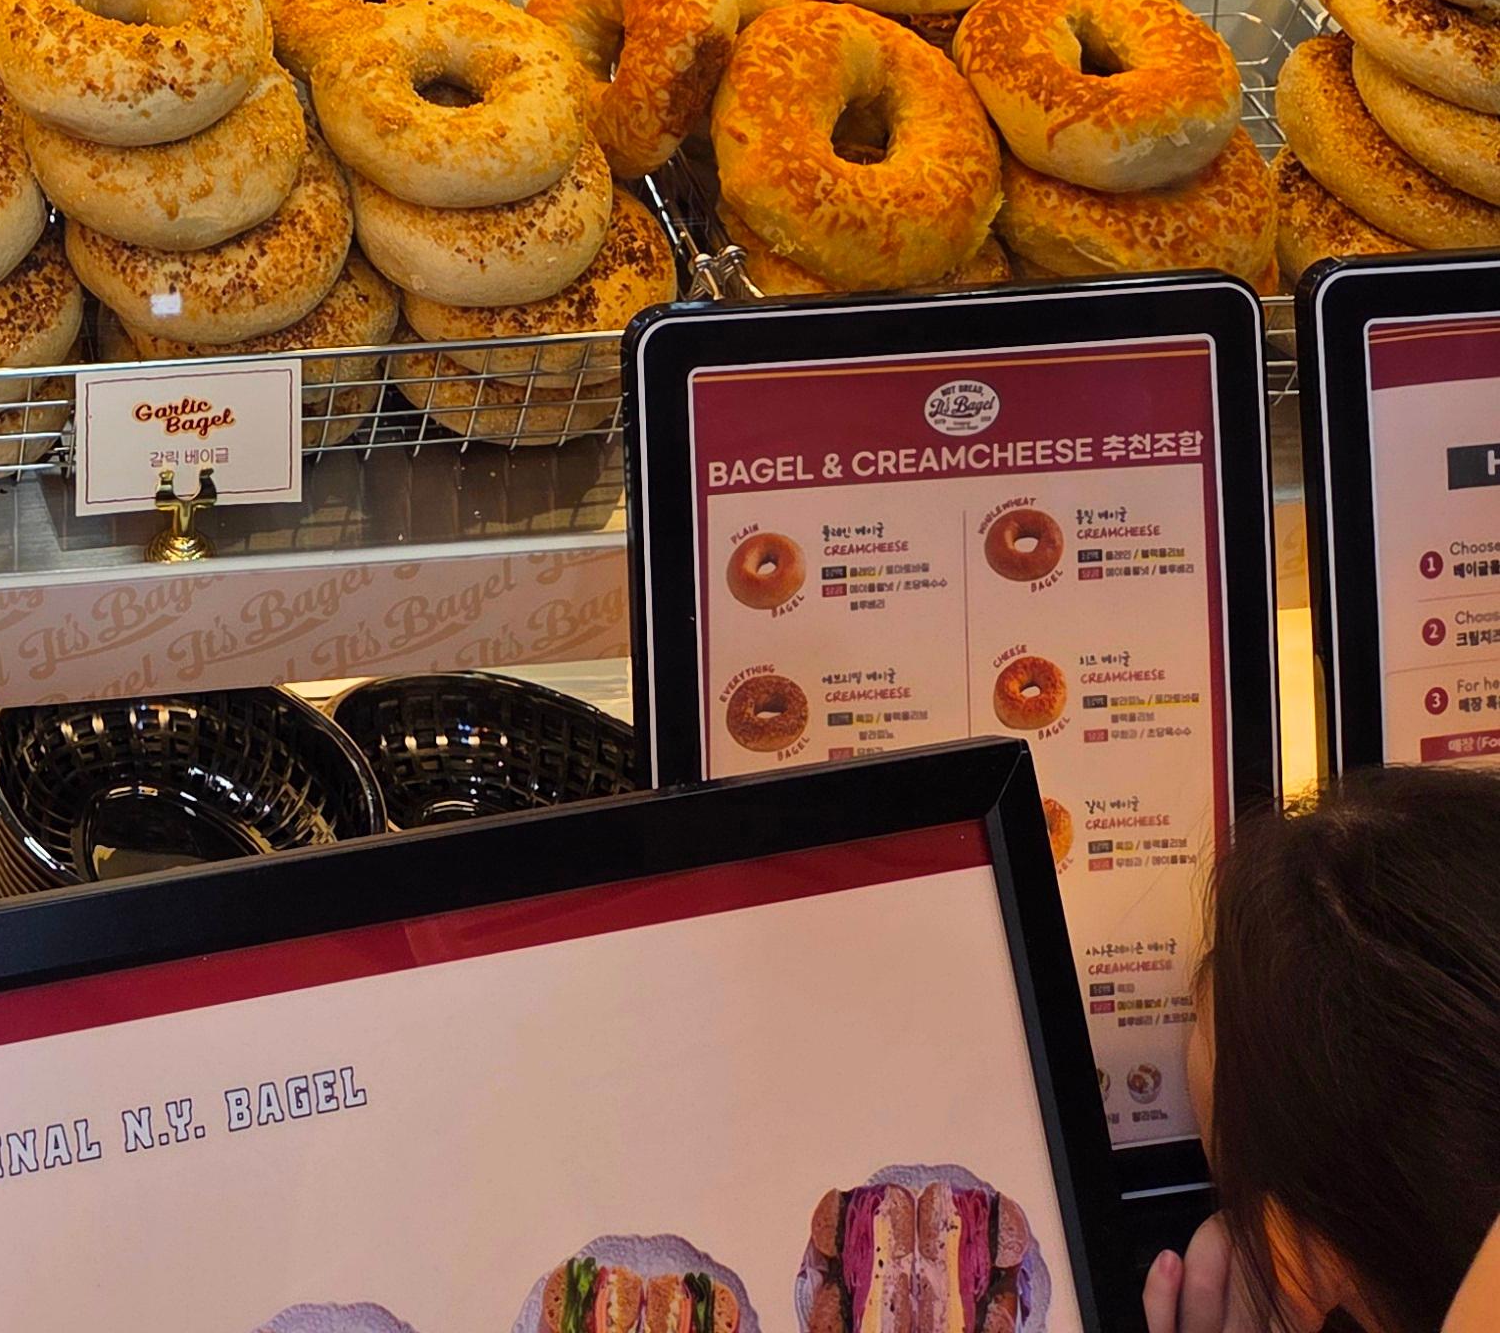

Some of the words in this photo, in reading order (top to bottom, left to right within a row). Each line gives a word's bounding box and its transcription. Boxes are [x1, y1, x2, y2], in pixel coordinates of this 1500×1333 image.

[134, 398, 212, 422] Garlic
[165, 409, 236, 437] Bagel
[149, 450, 180, 468] 갈릭
[184, 447, 230, 465] 베이글
[707, 454, 814, 488] BAGEL
[822, 452, 844, 479] &
[850, 436, 1095, 476] CREAMCHEESE
[1101, 430, 1205, 463] 추천조합
[1076, 524, 1162, 540] CREAMCHEESE
[822, 540, 910, 557] CREAMCHEESE
[1080, 668, 1166, 684] CREAMCHEESE
[824, 686, 912, 704] CREAMCHEESE
[1084, 813, 1171, 831] CREAMCHEESE
[121, 1095, 207, 1153] N.Y.
[224, 1064, 369, 1134] BAGEL
